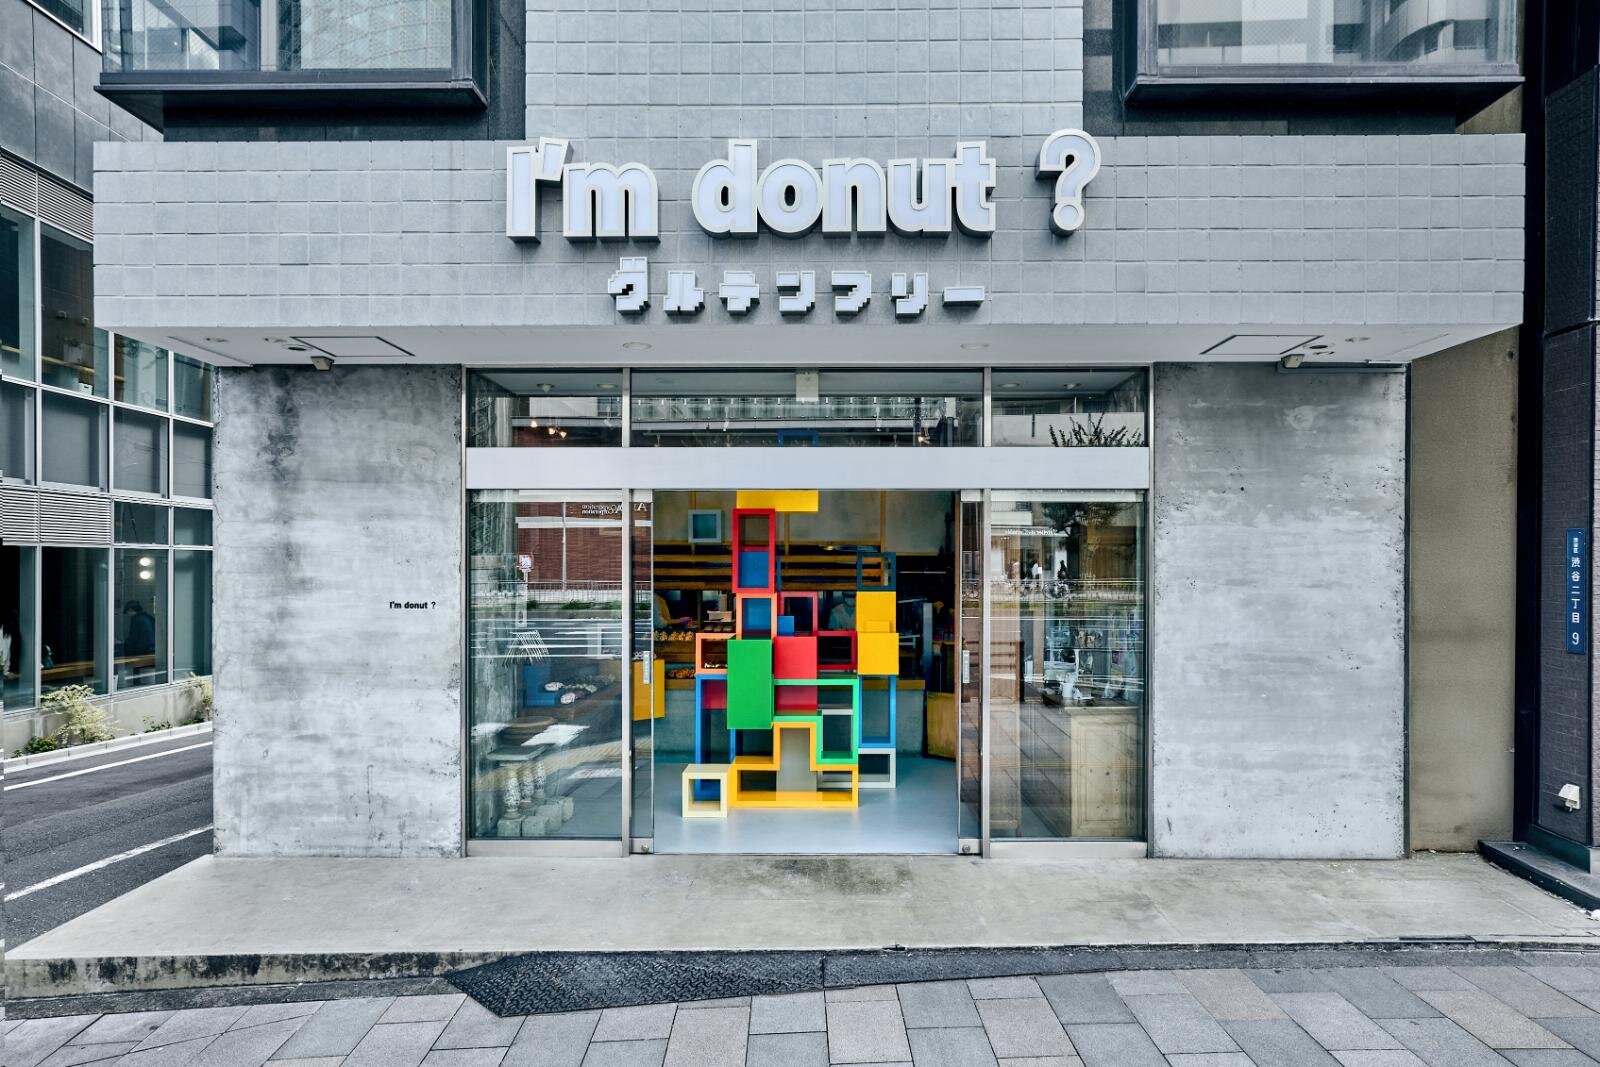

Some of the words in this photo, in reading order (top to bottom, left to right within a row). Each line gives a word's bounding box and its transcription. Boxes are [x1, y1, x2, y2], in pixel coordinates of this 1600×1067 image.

[506, 136, 661, 243] I'm
[692, 138, 996, 239] donut
[1036, 128, 1101, 237] ?
[607, 256, 986, 318] グルテンフリー
[389, 601, 402, 609] I'm
[404, 601, 428, 609] donut
[431, 601, 436, 609] ?
[1571, 556, 1581, 624] 渋谷二丁目
[1571, 632, 1580, 645] 9
